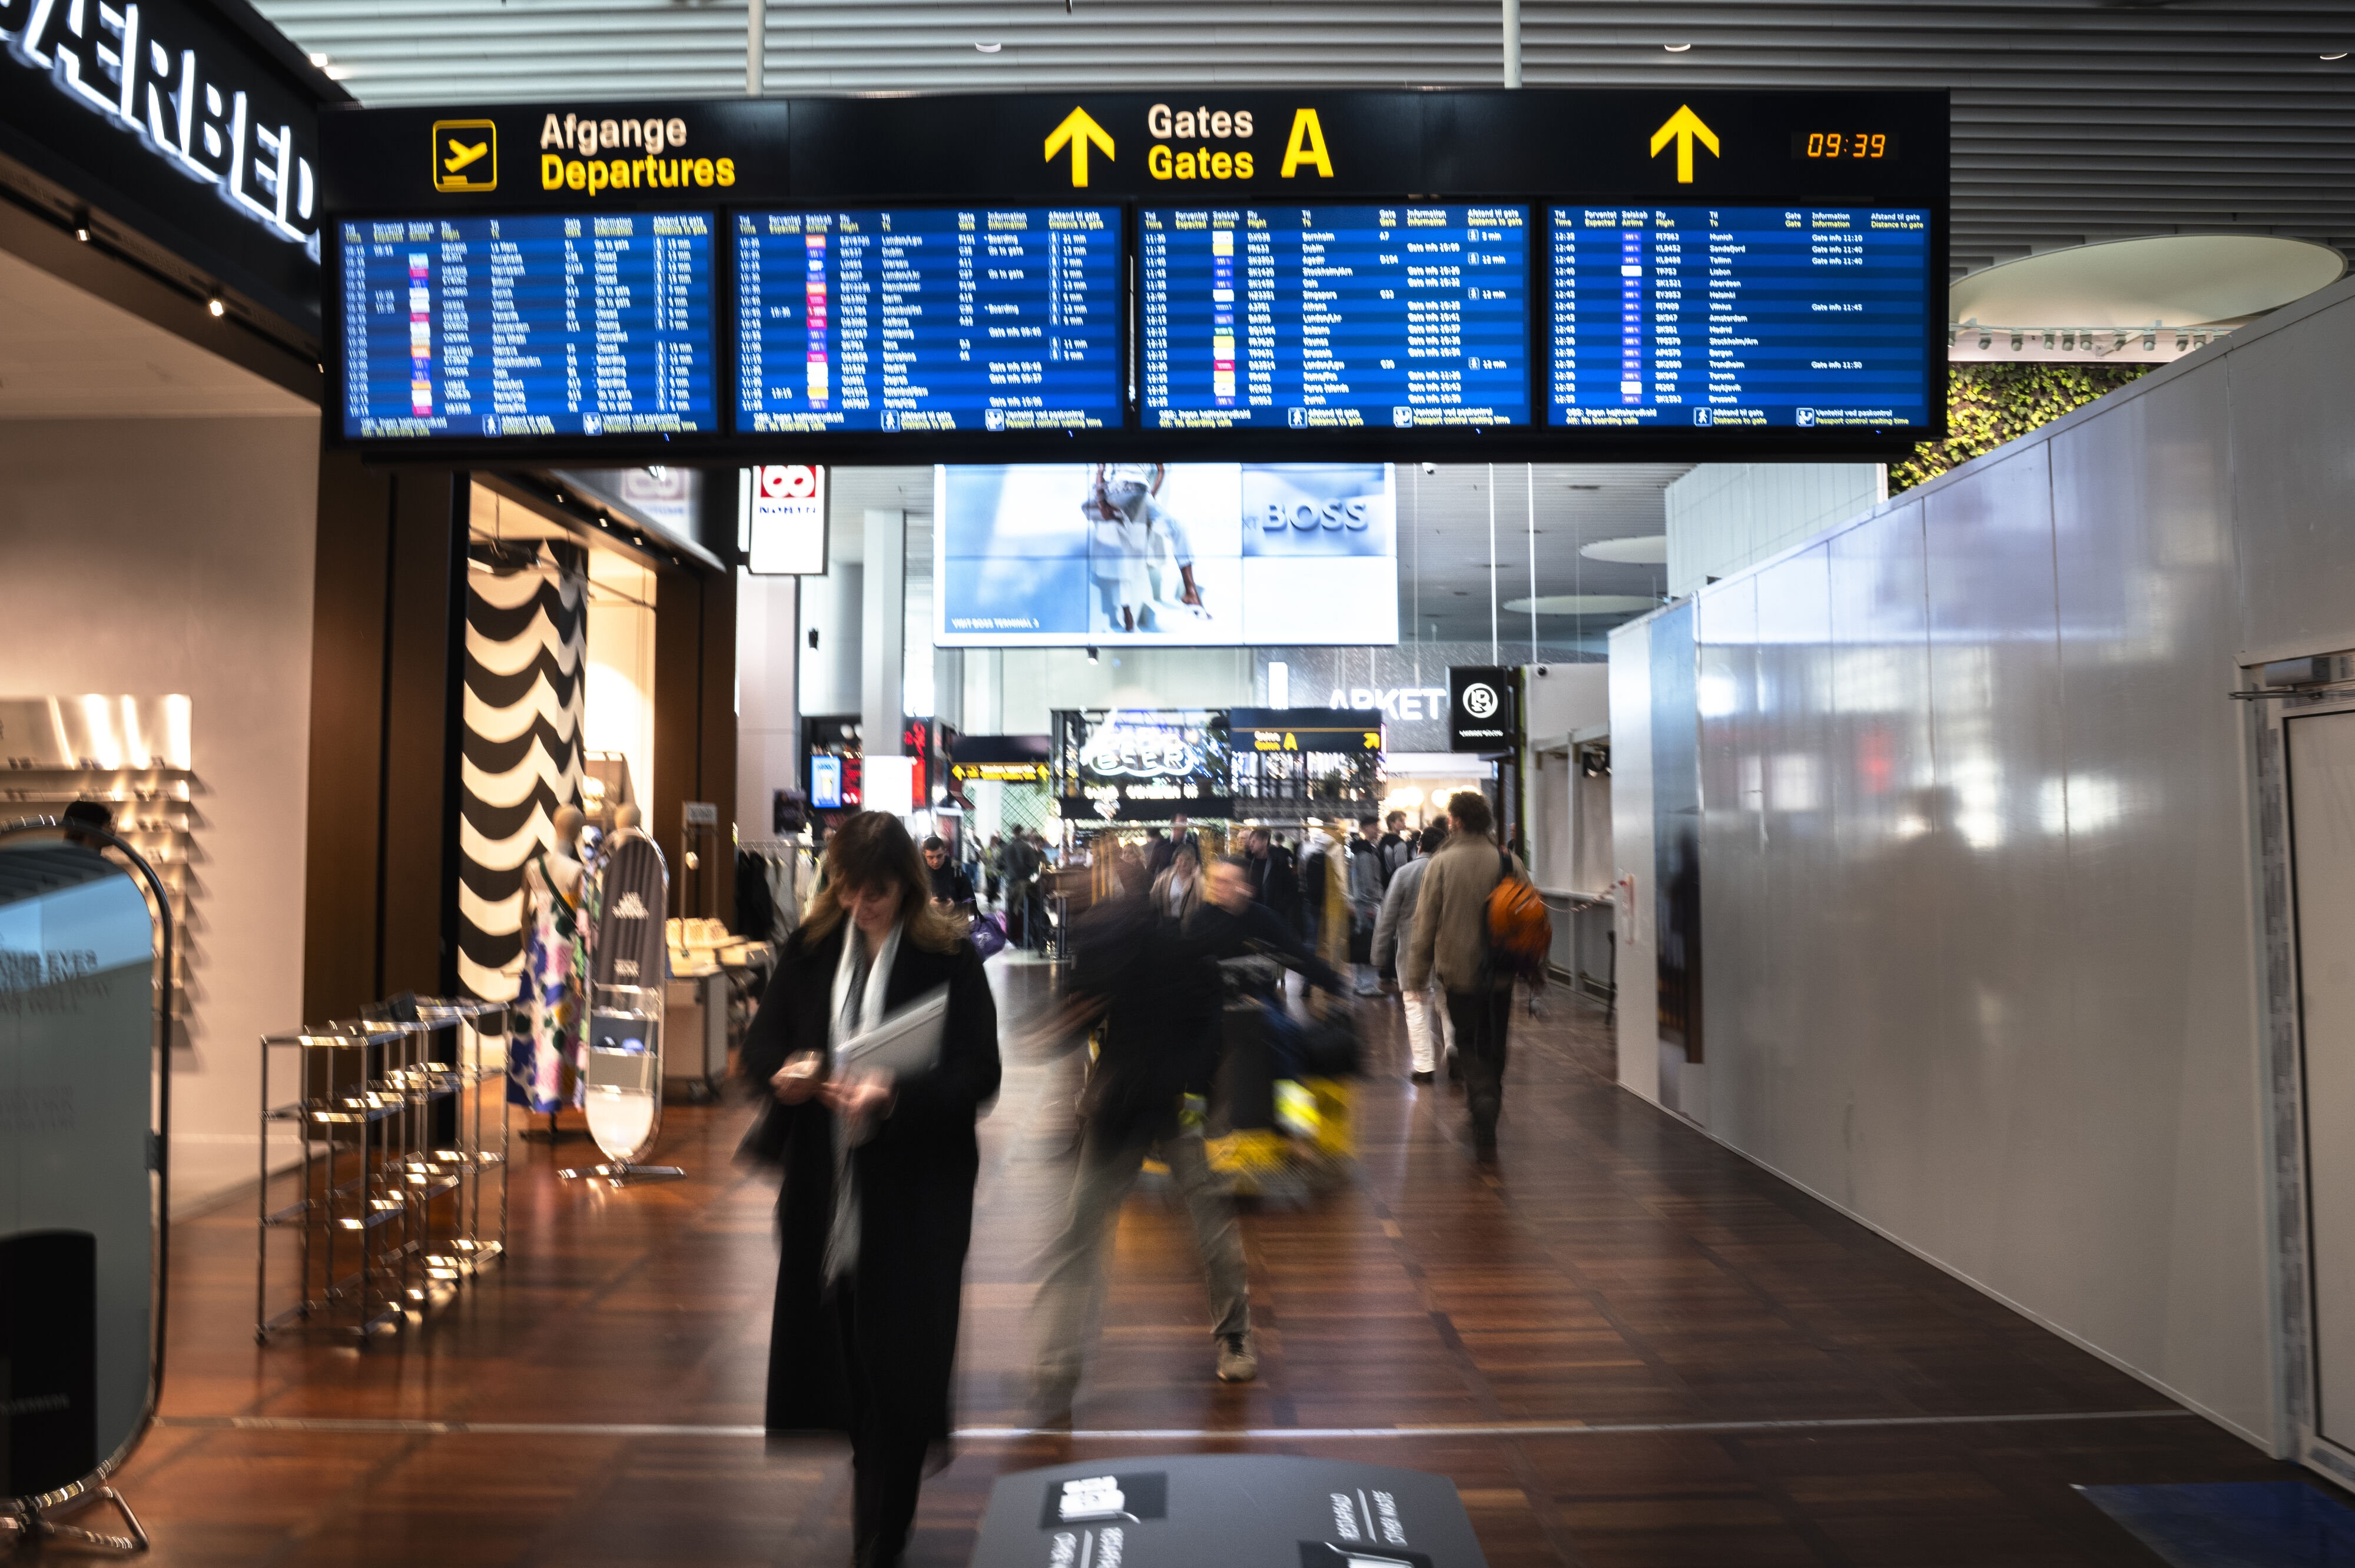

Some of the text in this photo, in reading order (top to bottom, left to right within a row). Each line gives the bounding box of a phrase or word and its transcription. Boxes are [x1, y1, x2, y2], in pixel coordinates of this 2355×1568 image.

[1148, 104, 1253, 139] Gates
[540, 113, 686, 155] Afgange
[1148, 108, 1334, 180] Gates A
[1807, 133, 1886, 158] 09:39
[541, 154, 736, 197] Departures
[1785, 212, 1802, 220] Gate
[1812, 212, 1850, 220] Information
[1870, 212, 1896, 221] Afstand
[1785, 220, 1802, 228] Gate
[1812, 220, 1850, 228] Information
[1871, 221, 1899, 229] Distance
[1812, 234, 1828, 242] Gate
[1262, 501, 1368, 531] BOSS
[1283, 732, 1298, 751] A
